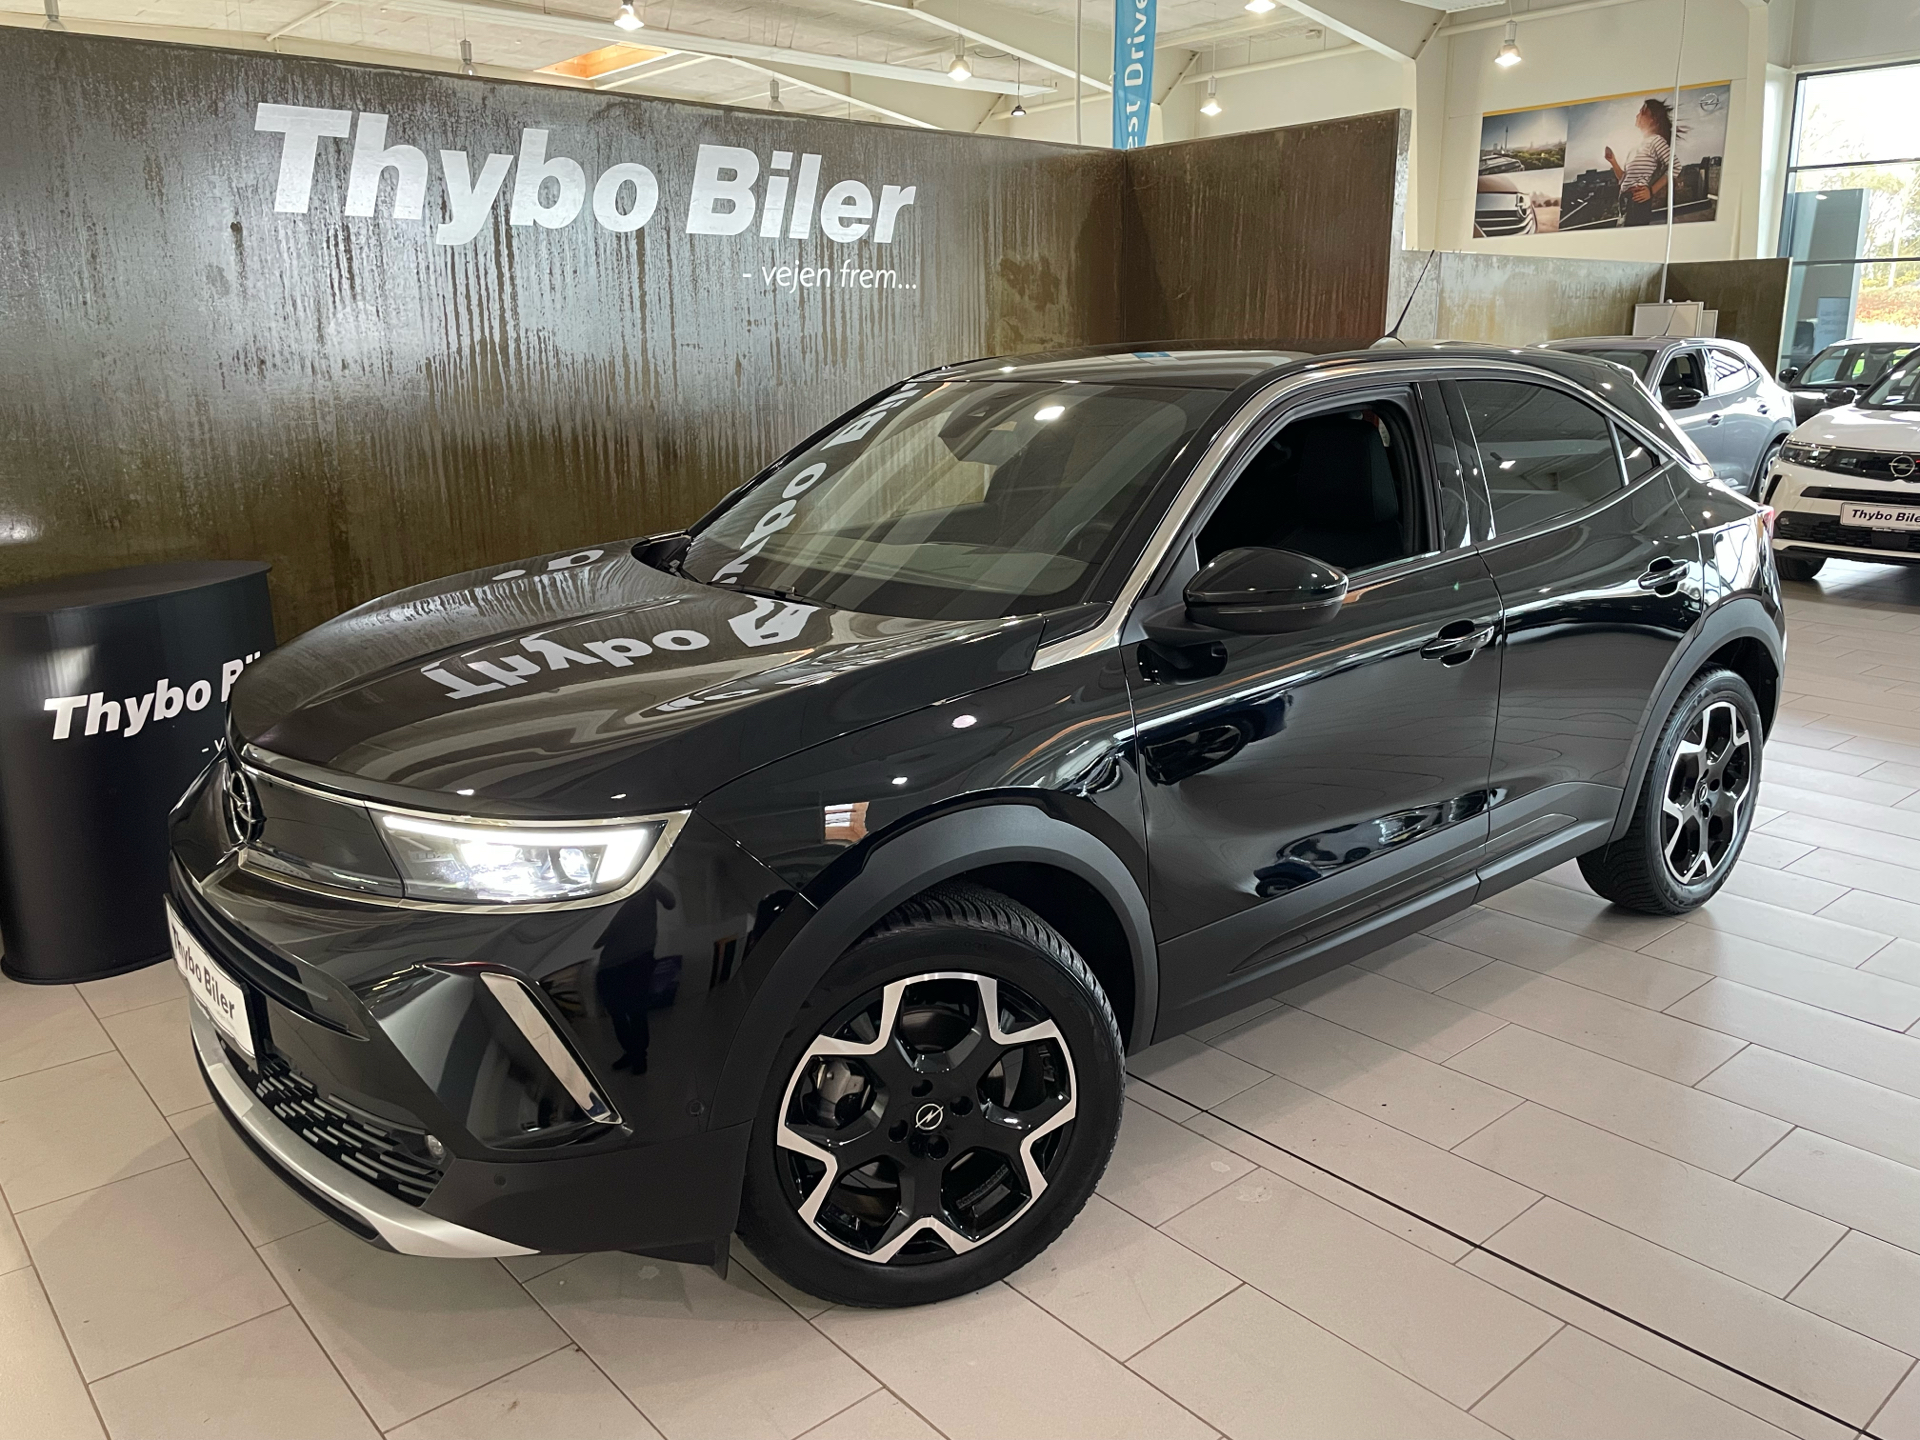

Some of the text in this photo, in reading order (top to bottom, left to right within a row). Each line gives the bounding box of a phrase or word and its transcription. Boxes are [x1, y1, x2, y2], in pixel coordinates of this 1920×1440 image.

[1126, 100, 1140, 149] est
[254, 102, 918, 246] Thybo Biler
[761, 259, 831, 294] vejen
[839, 258, 917, 290] frem...
[1852, 509, 1920, 523] Thybo Bile
[43, 678, 212, 741] Thybo
[203, 965, 235, 1020] Biler
